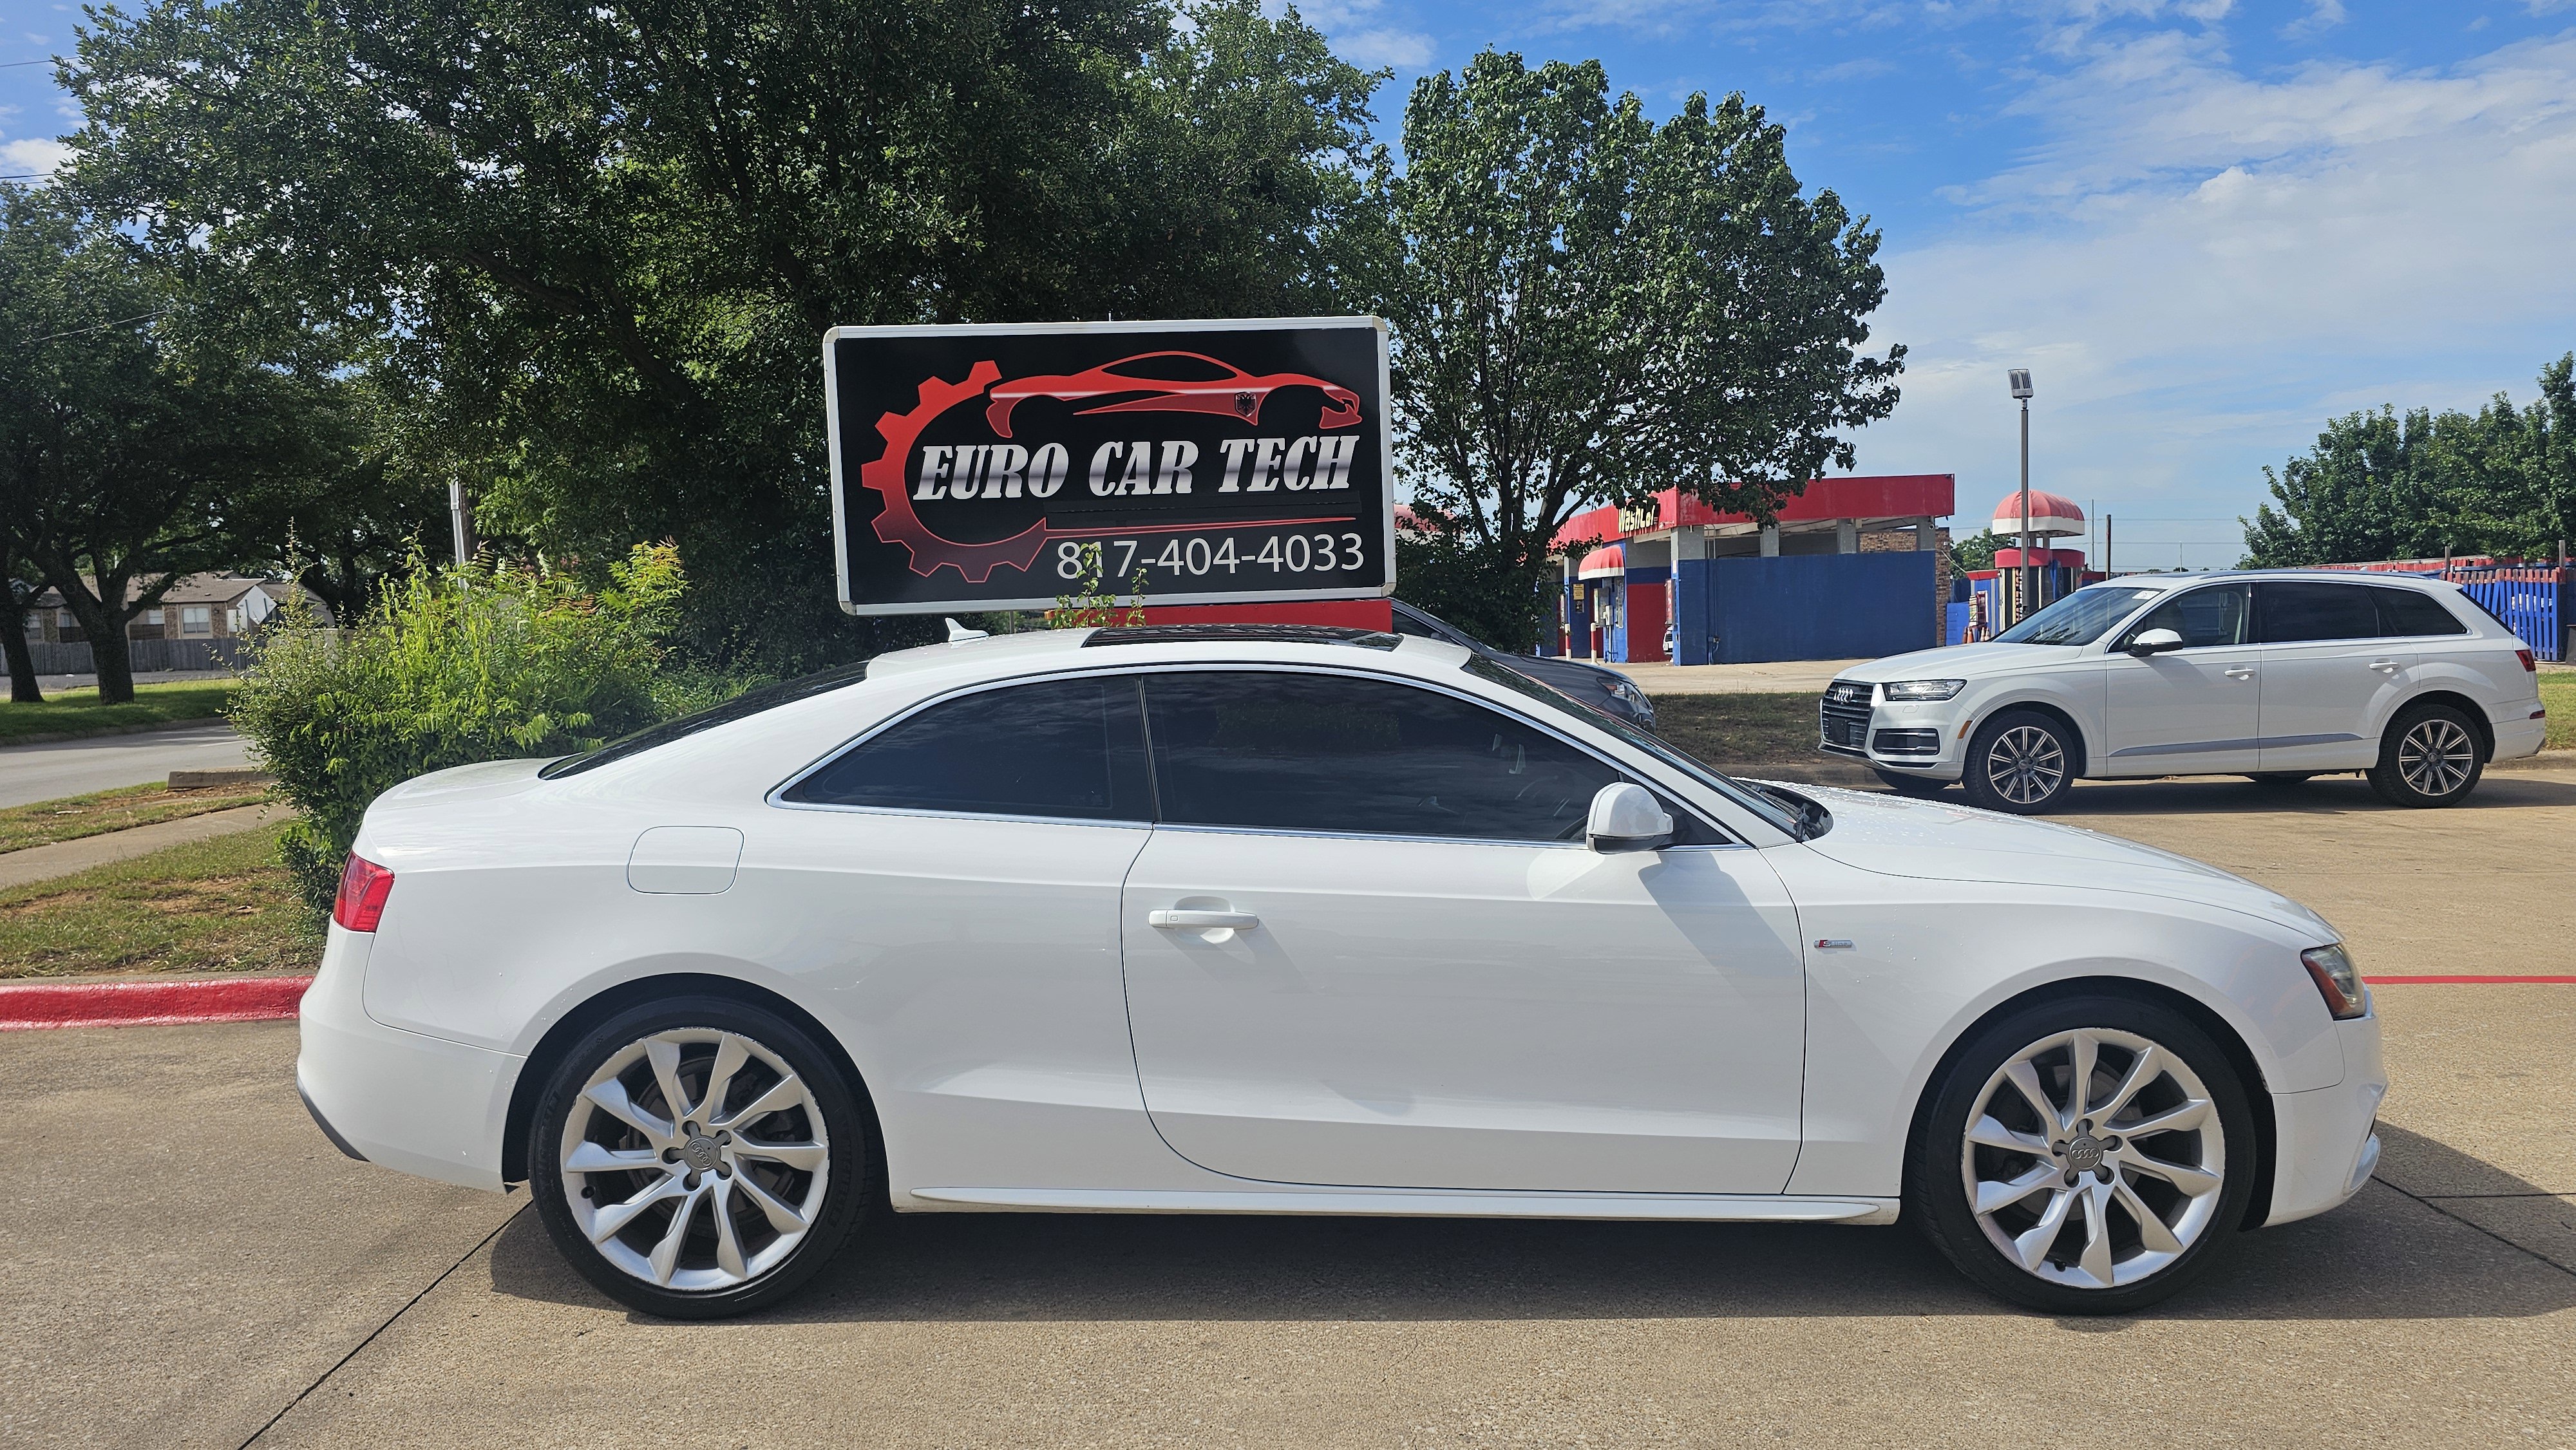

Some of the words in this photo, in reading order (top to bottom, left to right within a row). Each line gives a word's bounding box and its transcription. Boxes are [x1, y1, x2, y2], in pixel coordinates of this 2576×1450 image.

[913, 442, 1069, 500] EURO
[1089, 441, 1199, 496] CAR
[1218, 435, 1360, 493] TECH
[1057, 532, 1364, 579] 817-404-4033
